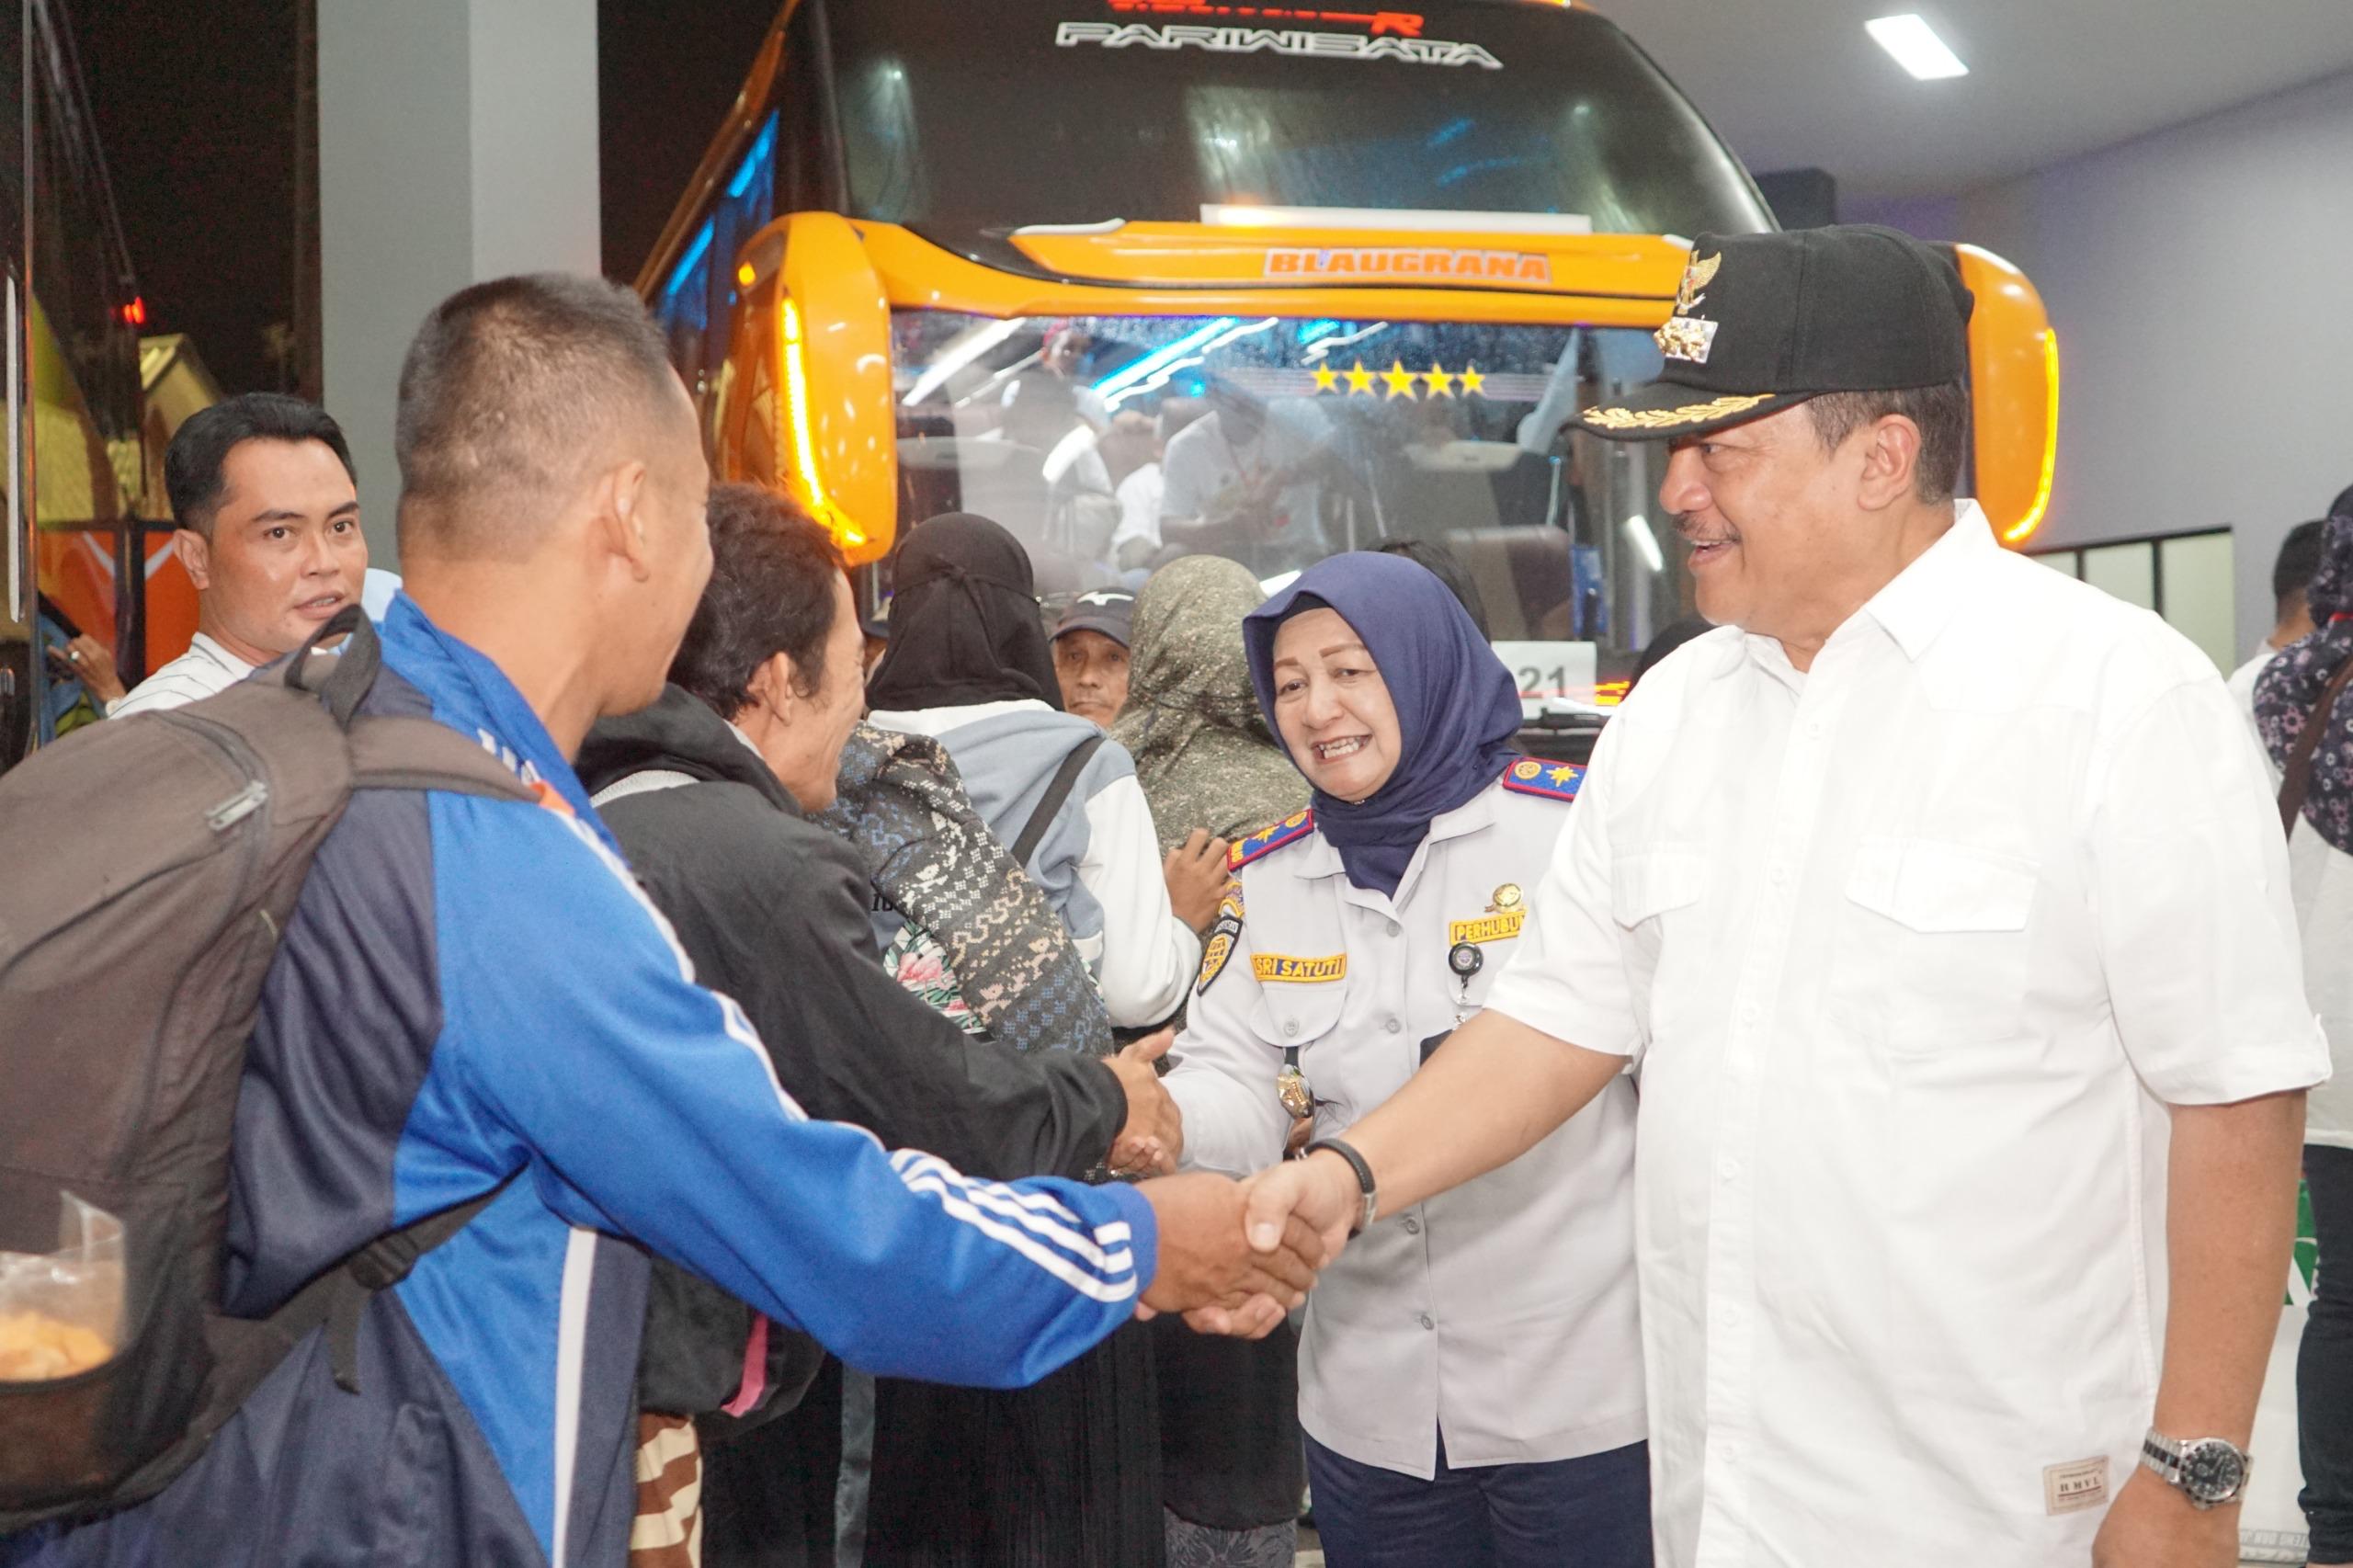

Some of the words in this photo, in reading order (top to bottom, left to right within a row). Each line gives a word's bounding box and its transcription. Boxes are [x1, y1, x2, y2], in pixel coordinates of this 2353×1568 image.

[1055, 21, 1505, 69] PARIWISATA
[1267, 251, 1549, 281] BLAUGRANA
[1256, 958, 1279, 976] SRI
[1280, 959, 1341, 978] SATUTI
